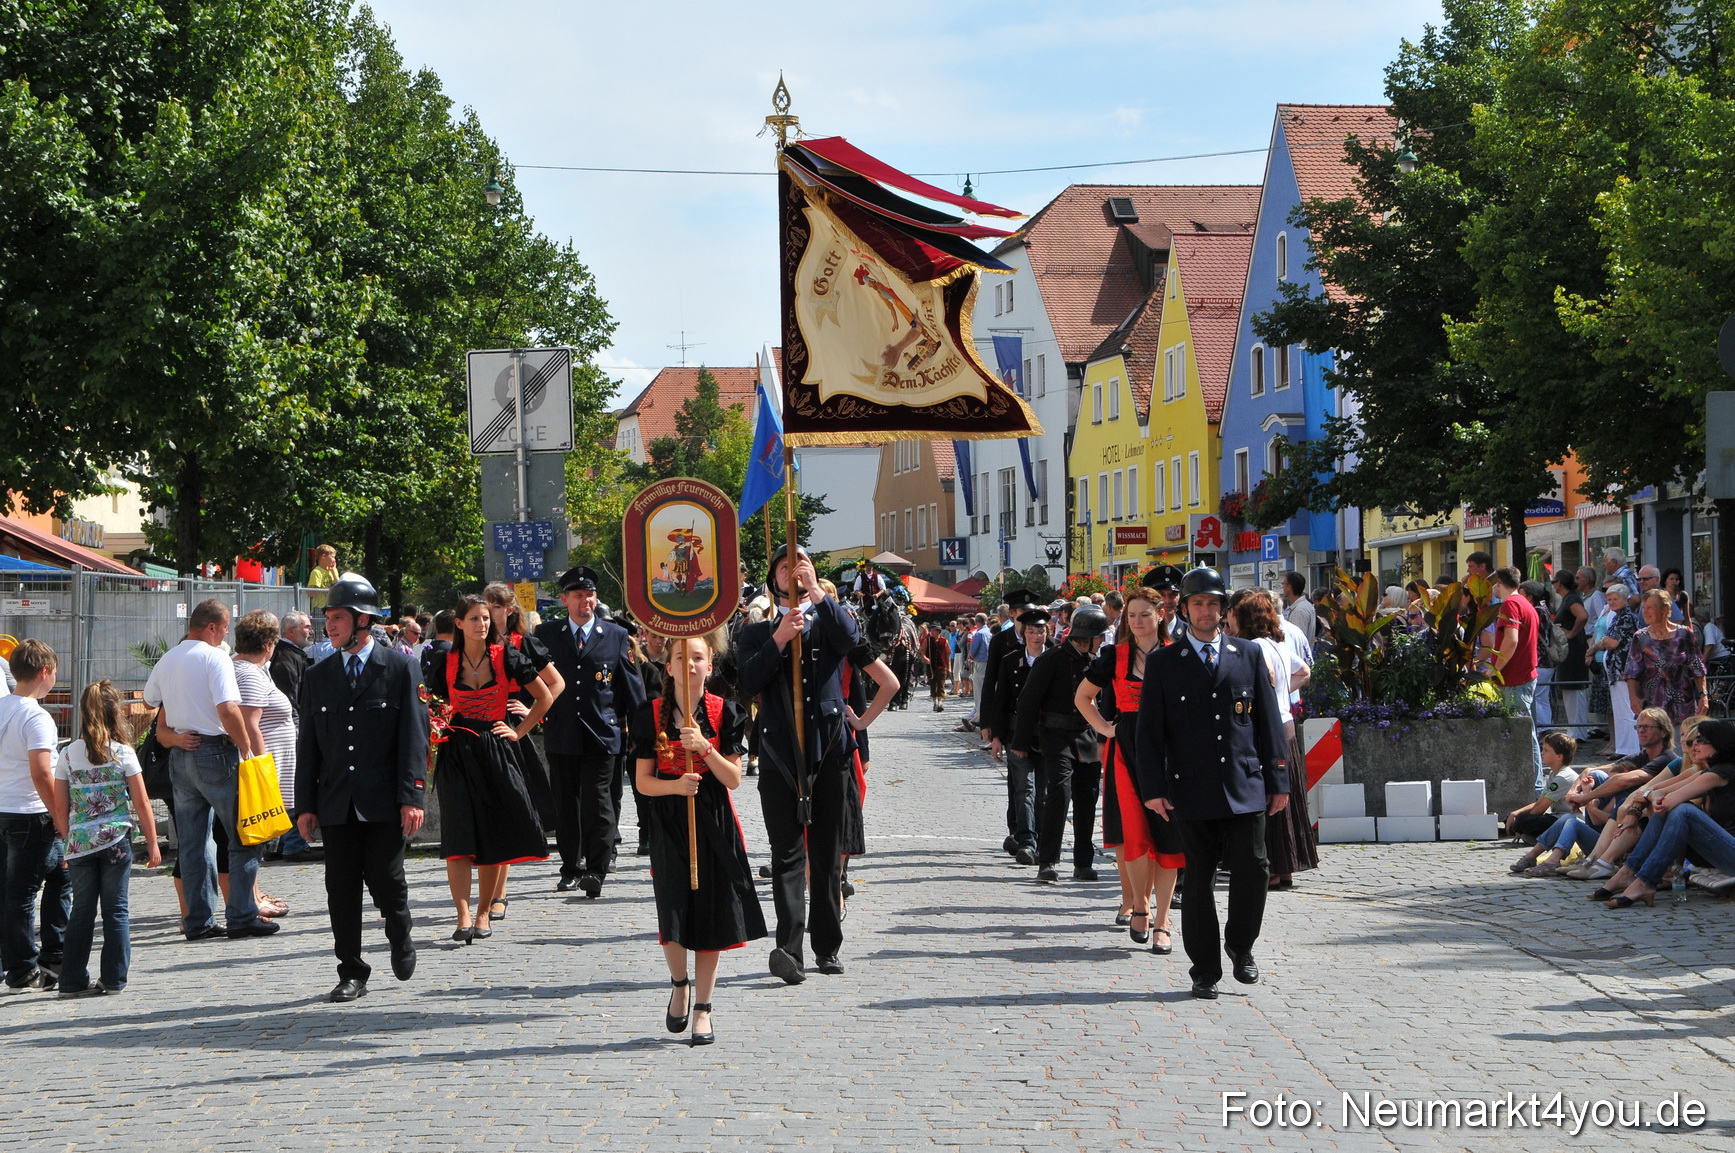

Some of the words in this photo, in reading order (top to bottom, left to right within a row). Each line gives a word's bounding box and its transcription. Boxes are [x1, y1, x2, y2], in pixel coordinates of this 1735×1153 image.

[813, 249, 842, 296] Gott
[881, 370, 917, 389] Dem
[1102, 444, 1121, 465] HOTEL
[634, 483, 677, 516] Freiwillige
[676, 481, 726, 511] Feuerwehr
[1116, 531, 1147, 540] WISSMACH
[1265, 538, 1275, 559] P
[648, 612, 717, 632] Neumarkt/Opf
